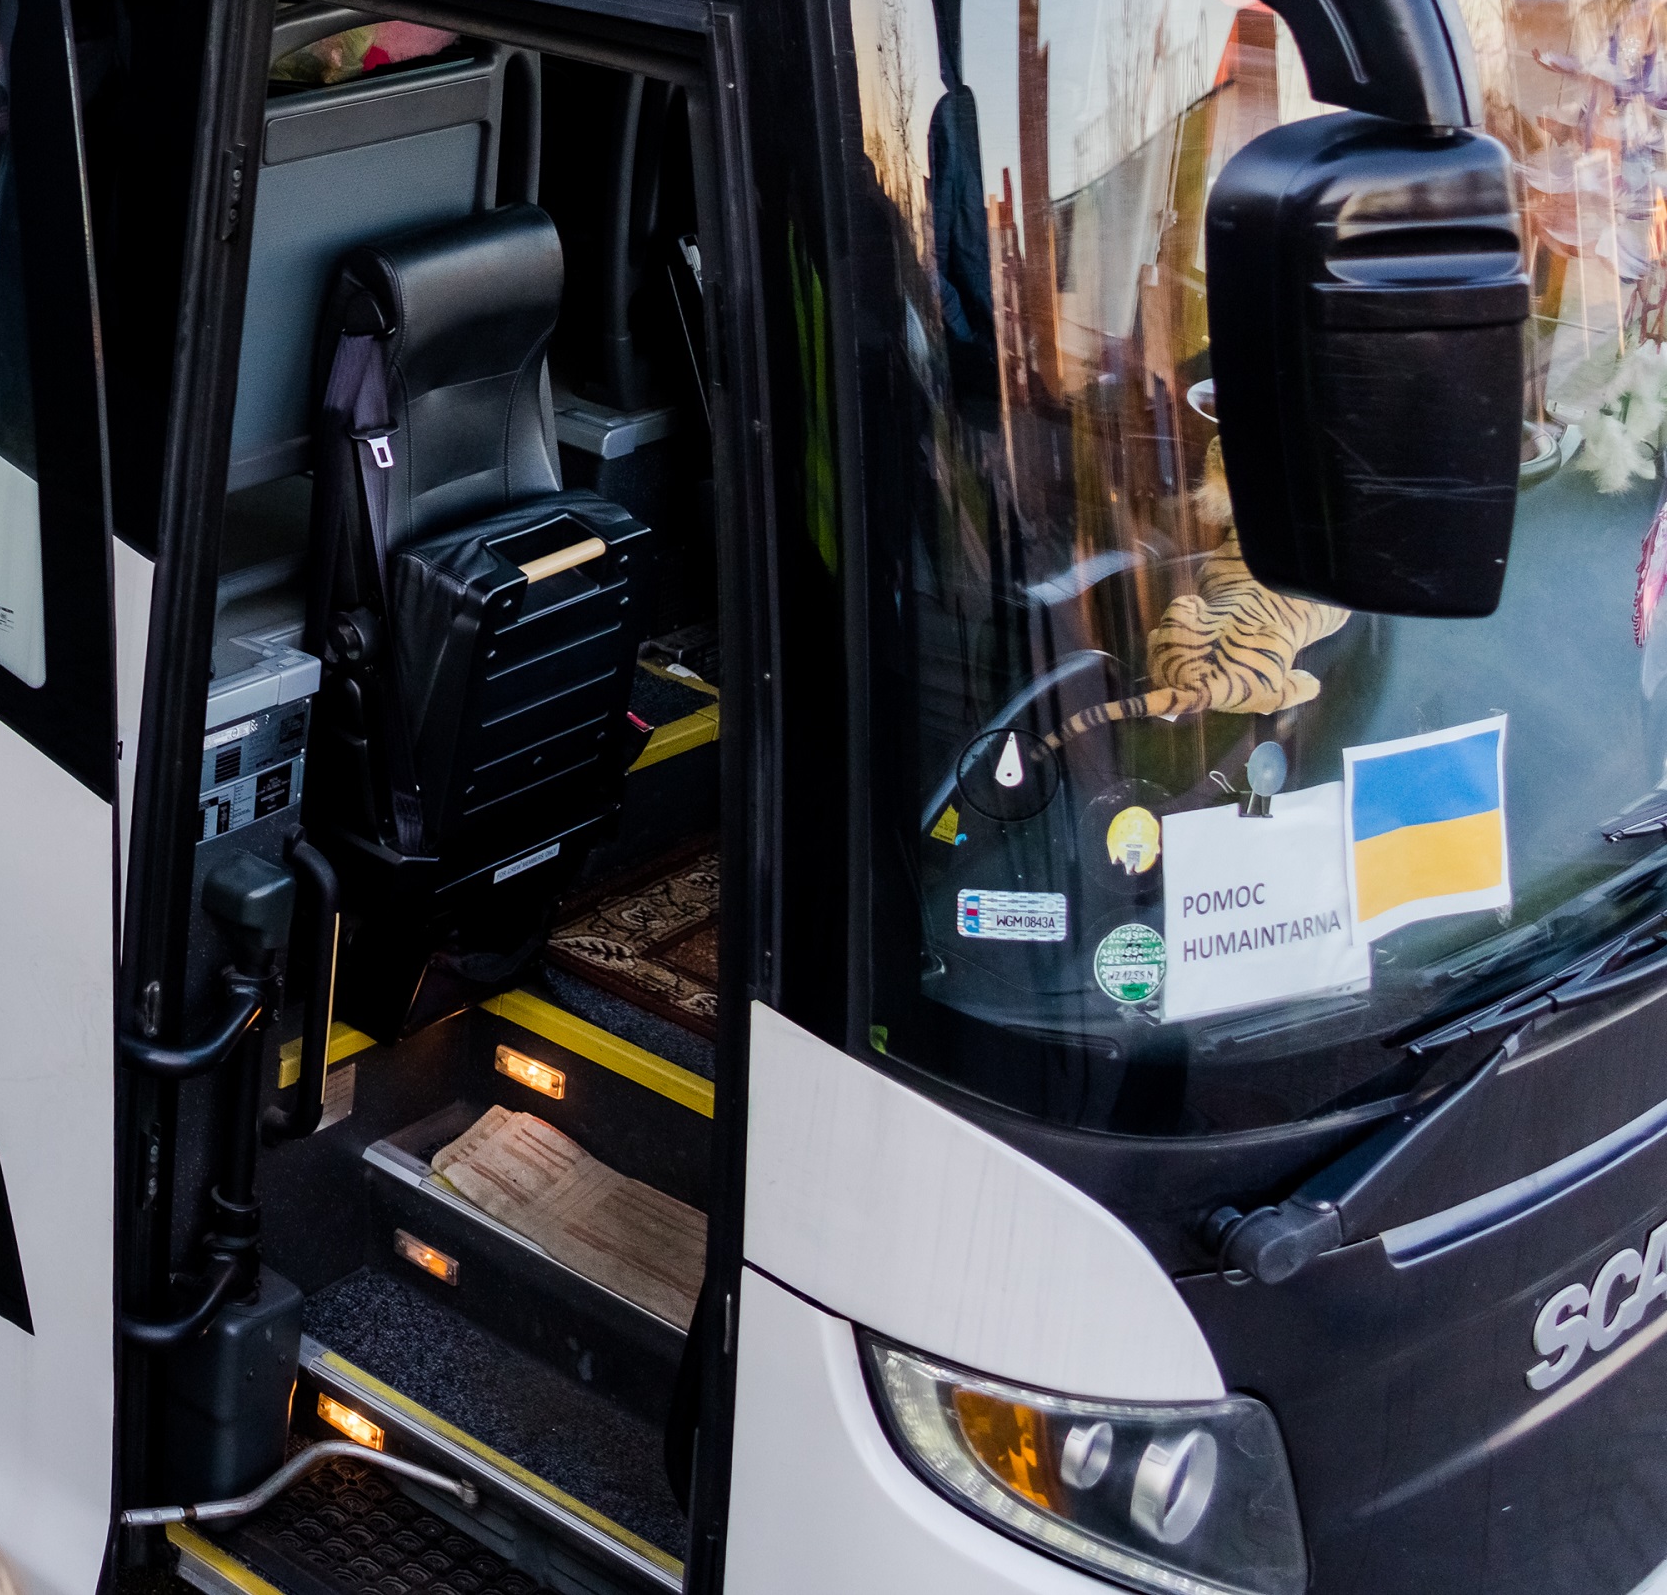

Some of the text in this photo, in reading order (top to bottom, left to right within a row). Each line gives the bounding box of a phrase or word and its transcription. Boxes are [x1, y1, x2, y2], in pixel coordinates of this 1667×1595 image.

[1183, 882, 1265, 918] POMOC
[996, 915, 1023, 927] WGM
[1024, 916, 1055, 928] 0843A
[1183, 910, 1342, 962] HUMAINTARNA
